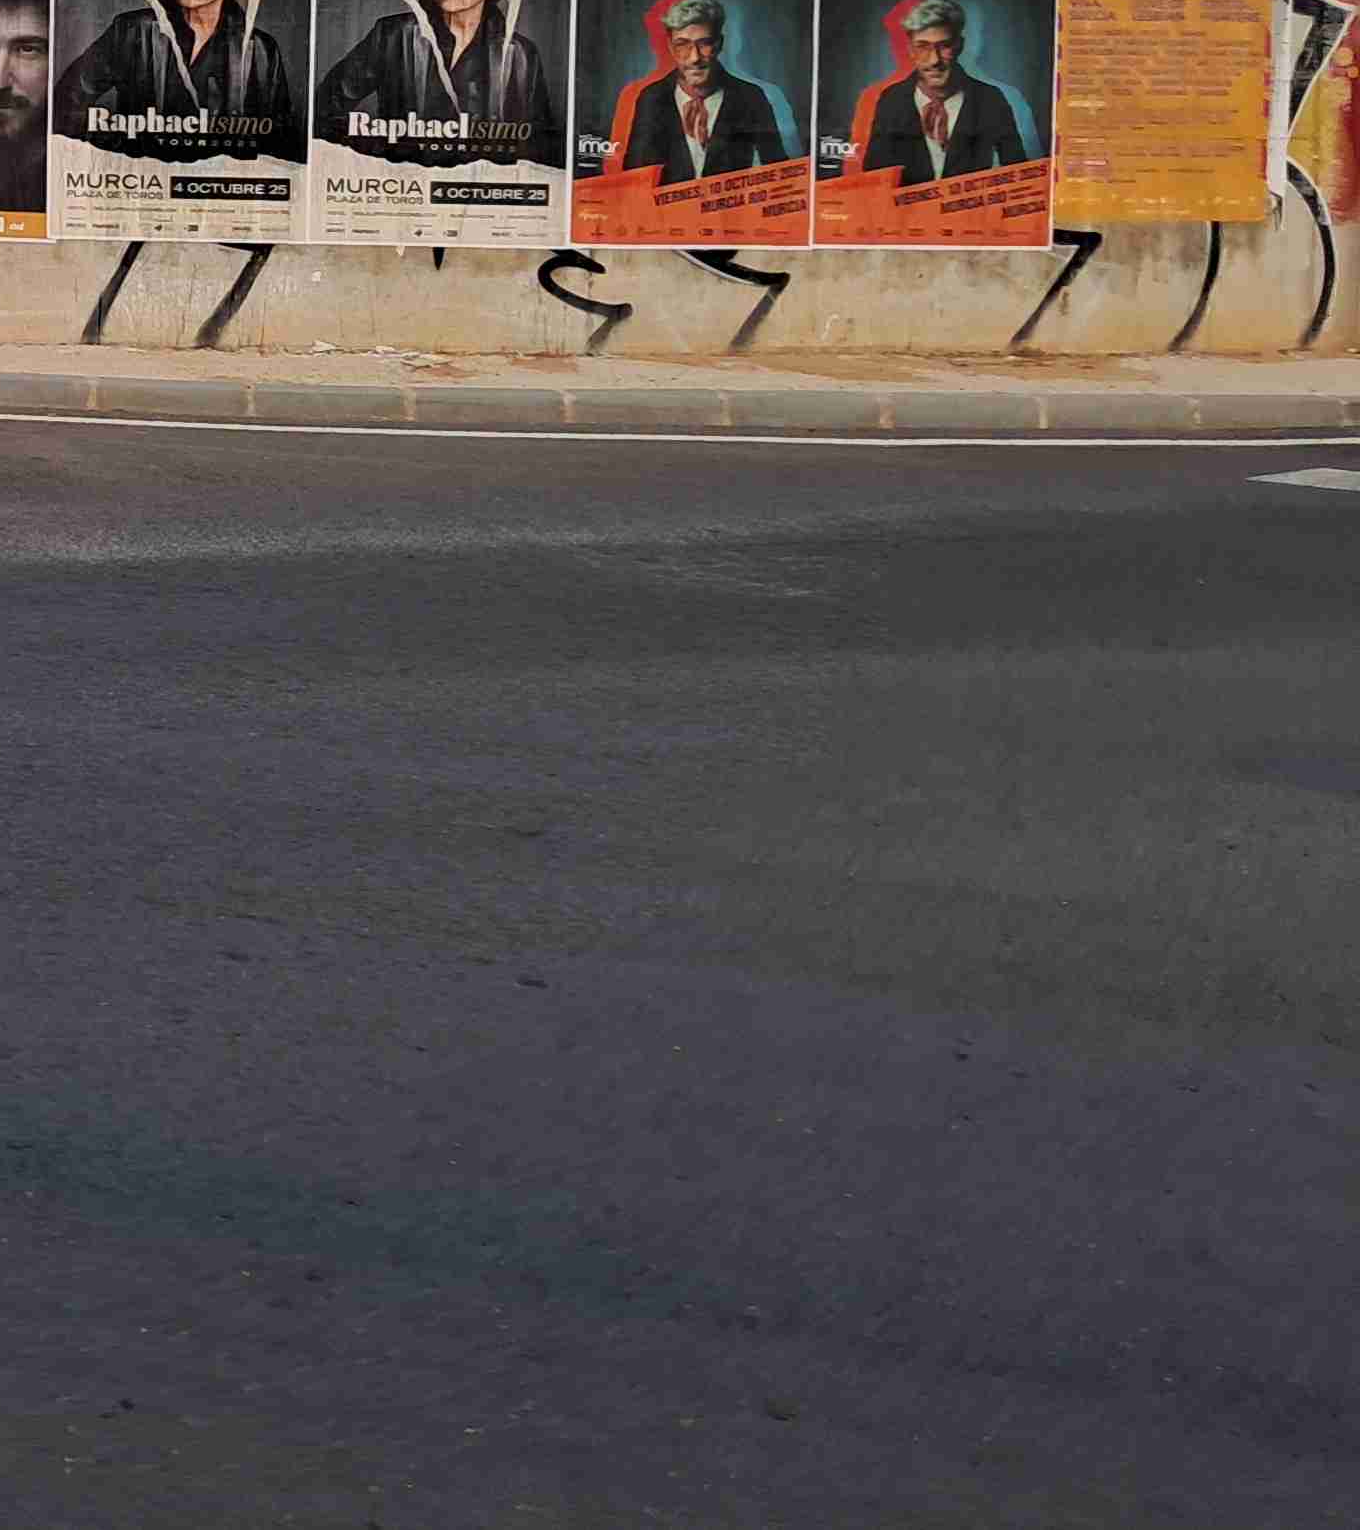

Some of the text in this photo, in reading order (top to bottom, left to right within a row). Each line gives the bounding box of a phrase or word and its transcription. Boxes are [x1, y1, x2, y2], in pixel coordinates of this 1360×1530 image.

[156, 138, 208, 147] TOUR
[418, 143, 468, 152] TOUR
[66, 172, 289, 196] MURCIA 4 OCTUBRE 25
[326, 177, 548, 201] MURCIA 4 OCTUBRE 25
[654, 186, 705, 207] VIERNES,
[709, 181, 723, 195] 10
[723, 171, 777, 192] OCTUBRE
[66, 189, 165, 201] PLAZA DE TOROS
[326, 195, 425, 206] PLAZA DE TOROS
[700, 195, 746, 215] MURCIA
[940, 195, 985, 215] MURCIA
[762, 198, 808, 218] MURCIA
[1001, 199, 1047, 219] MURCIA
